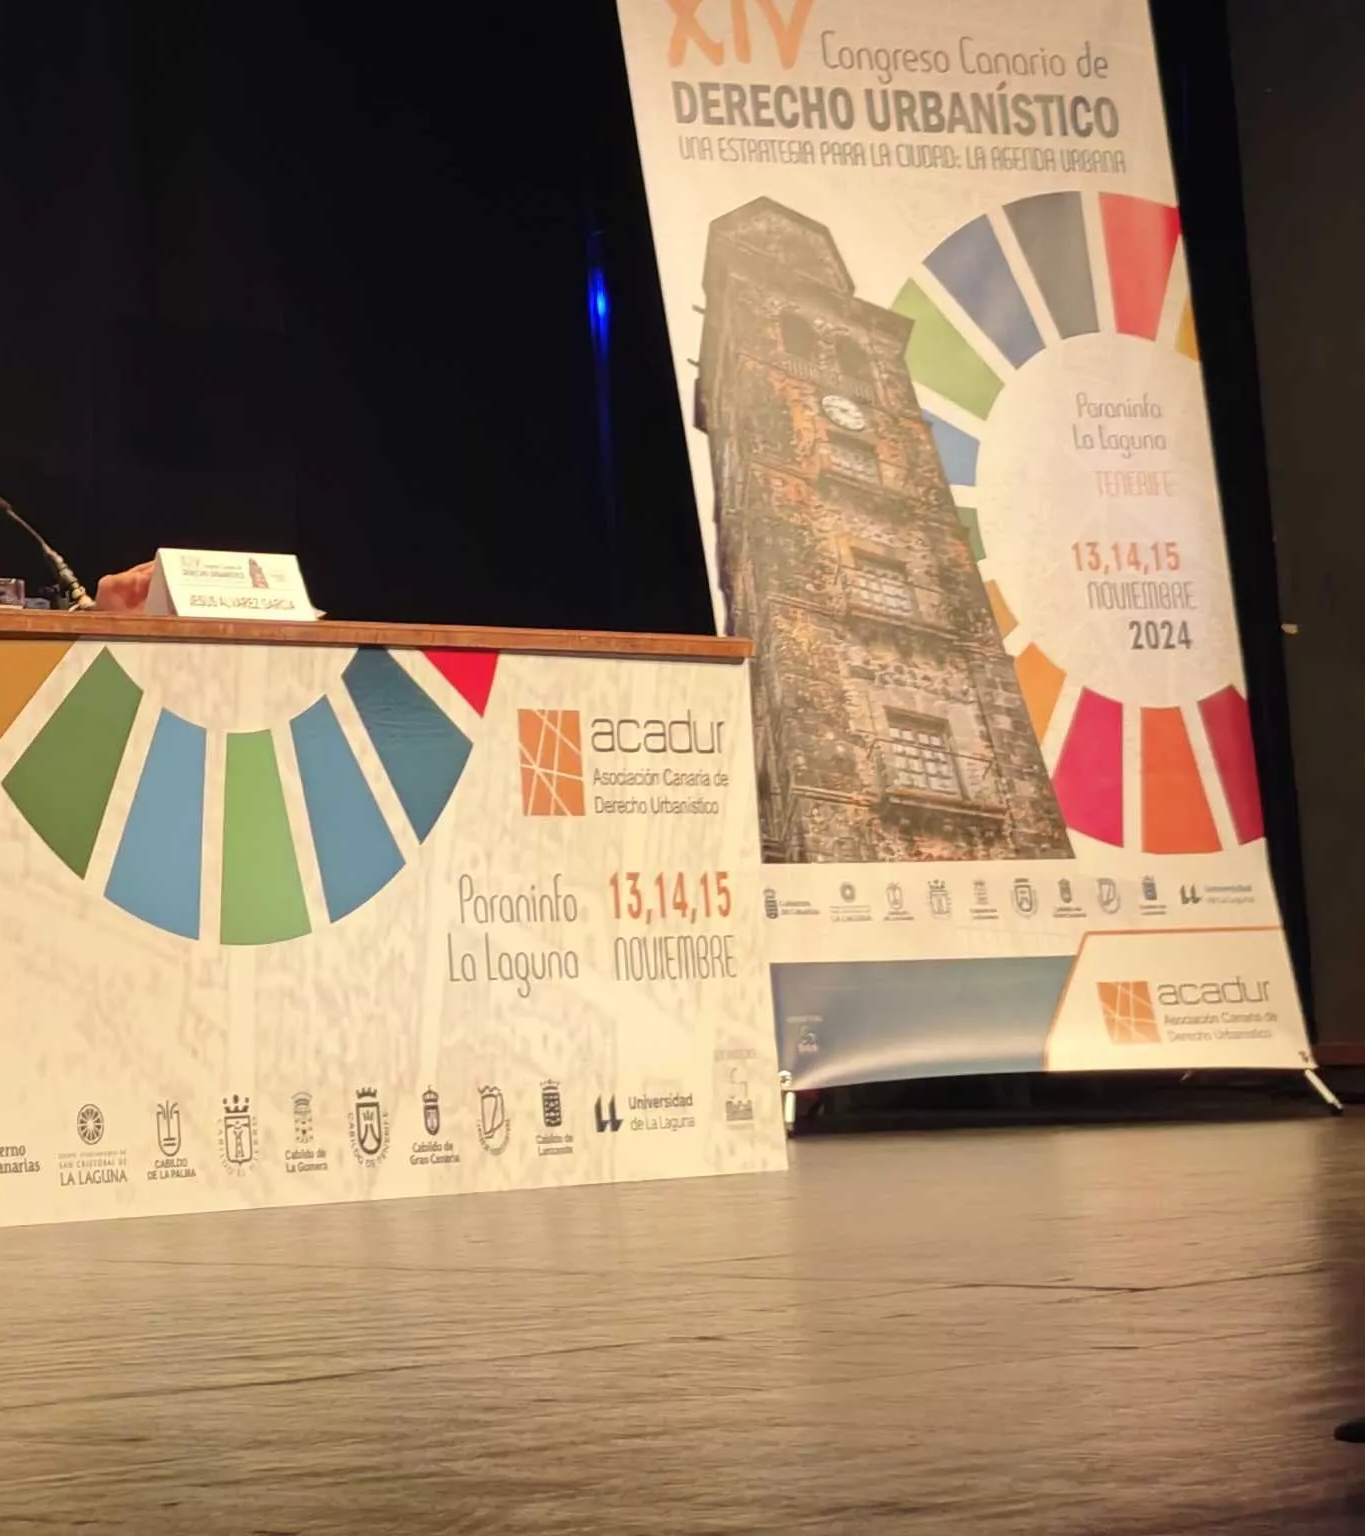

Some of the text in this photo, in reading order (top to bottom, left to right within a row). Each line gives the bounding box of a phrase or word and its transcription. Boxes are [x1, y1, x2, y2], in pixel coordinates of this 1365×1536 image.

[820, 30, 1110, 83] Congreso Canario de
[671, 80, 1120, 139] DERECHO URBANÍSTICO
[678, 135, 1127, 175] UNA ESTRATEGIA PARA LA CIUDAD: LA AGENDA URBANA
[1074, 392, 1162, 420] Paraninfo
[1072, 424, 1168, 460] La Laguna
[1094, 469, 1175, 497] TENERIFE
[1070, 541, 1181, 576] 13,14,15
[1087, 580, 1198, 611] NOVIEMBRE
[1128, 620, 1193, 651] 2024
[590, 708, 725, 755] acadur
[592, 768, 730, 786] Asociación Canaria de
[594, 796, 720, 815] Derecho Urbanístico
[458, 873, 578, 924] Paraninfo
[608, 871, 732, 926] 13,14,15
[447, 932, 580, 999] La Laguna
[613, 934, 738, 982] NOVIEMBRE
[1157, 975, 1270, 1006] acadur
[628, 1092, 694, 1110] Universidad
[630, 1115, 696, 1133] de La Laguna
[59, 1169, 129, 1187] LA LAGUNA
[154, 1157, 188, 1169] CABILDO
[171, 1168, 197, 1179] PALMA
